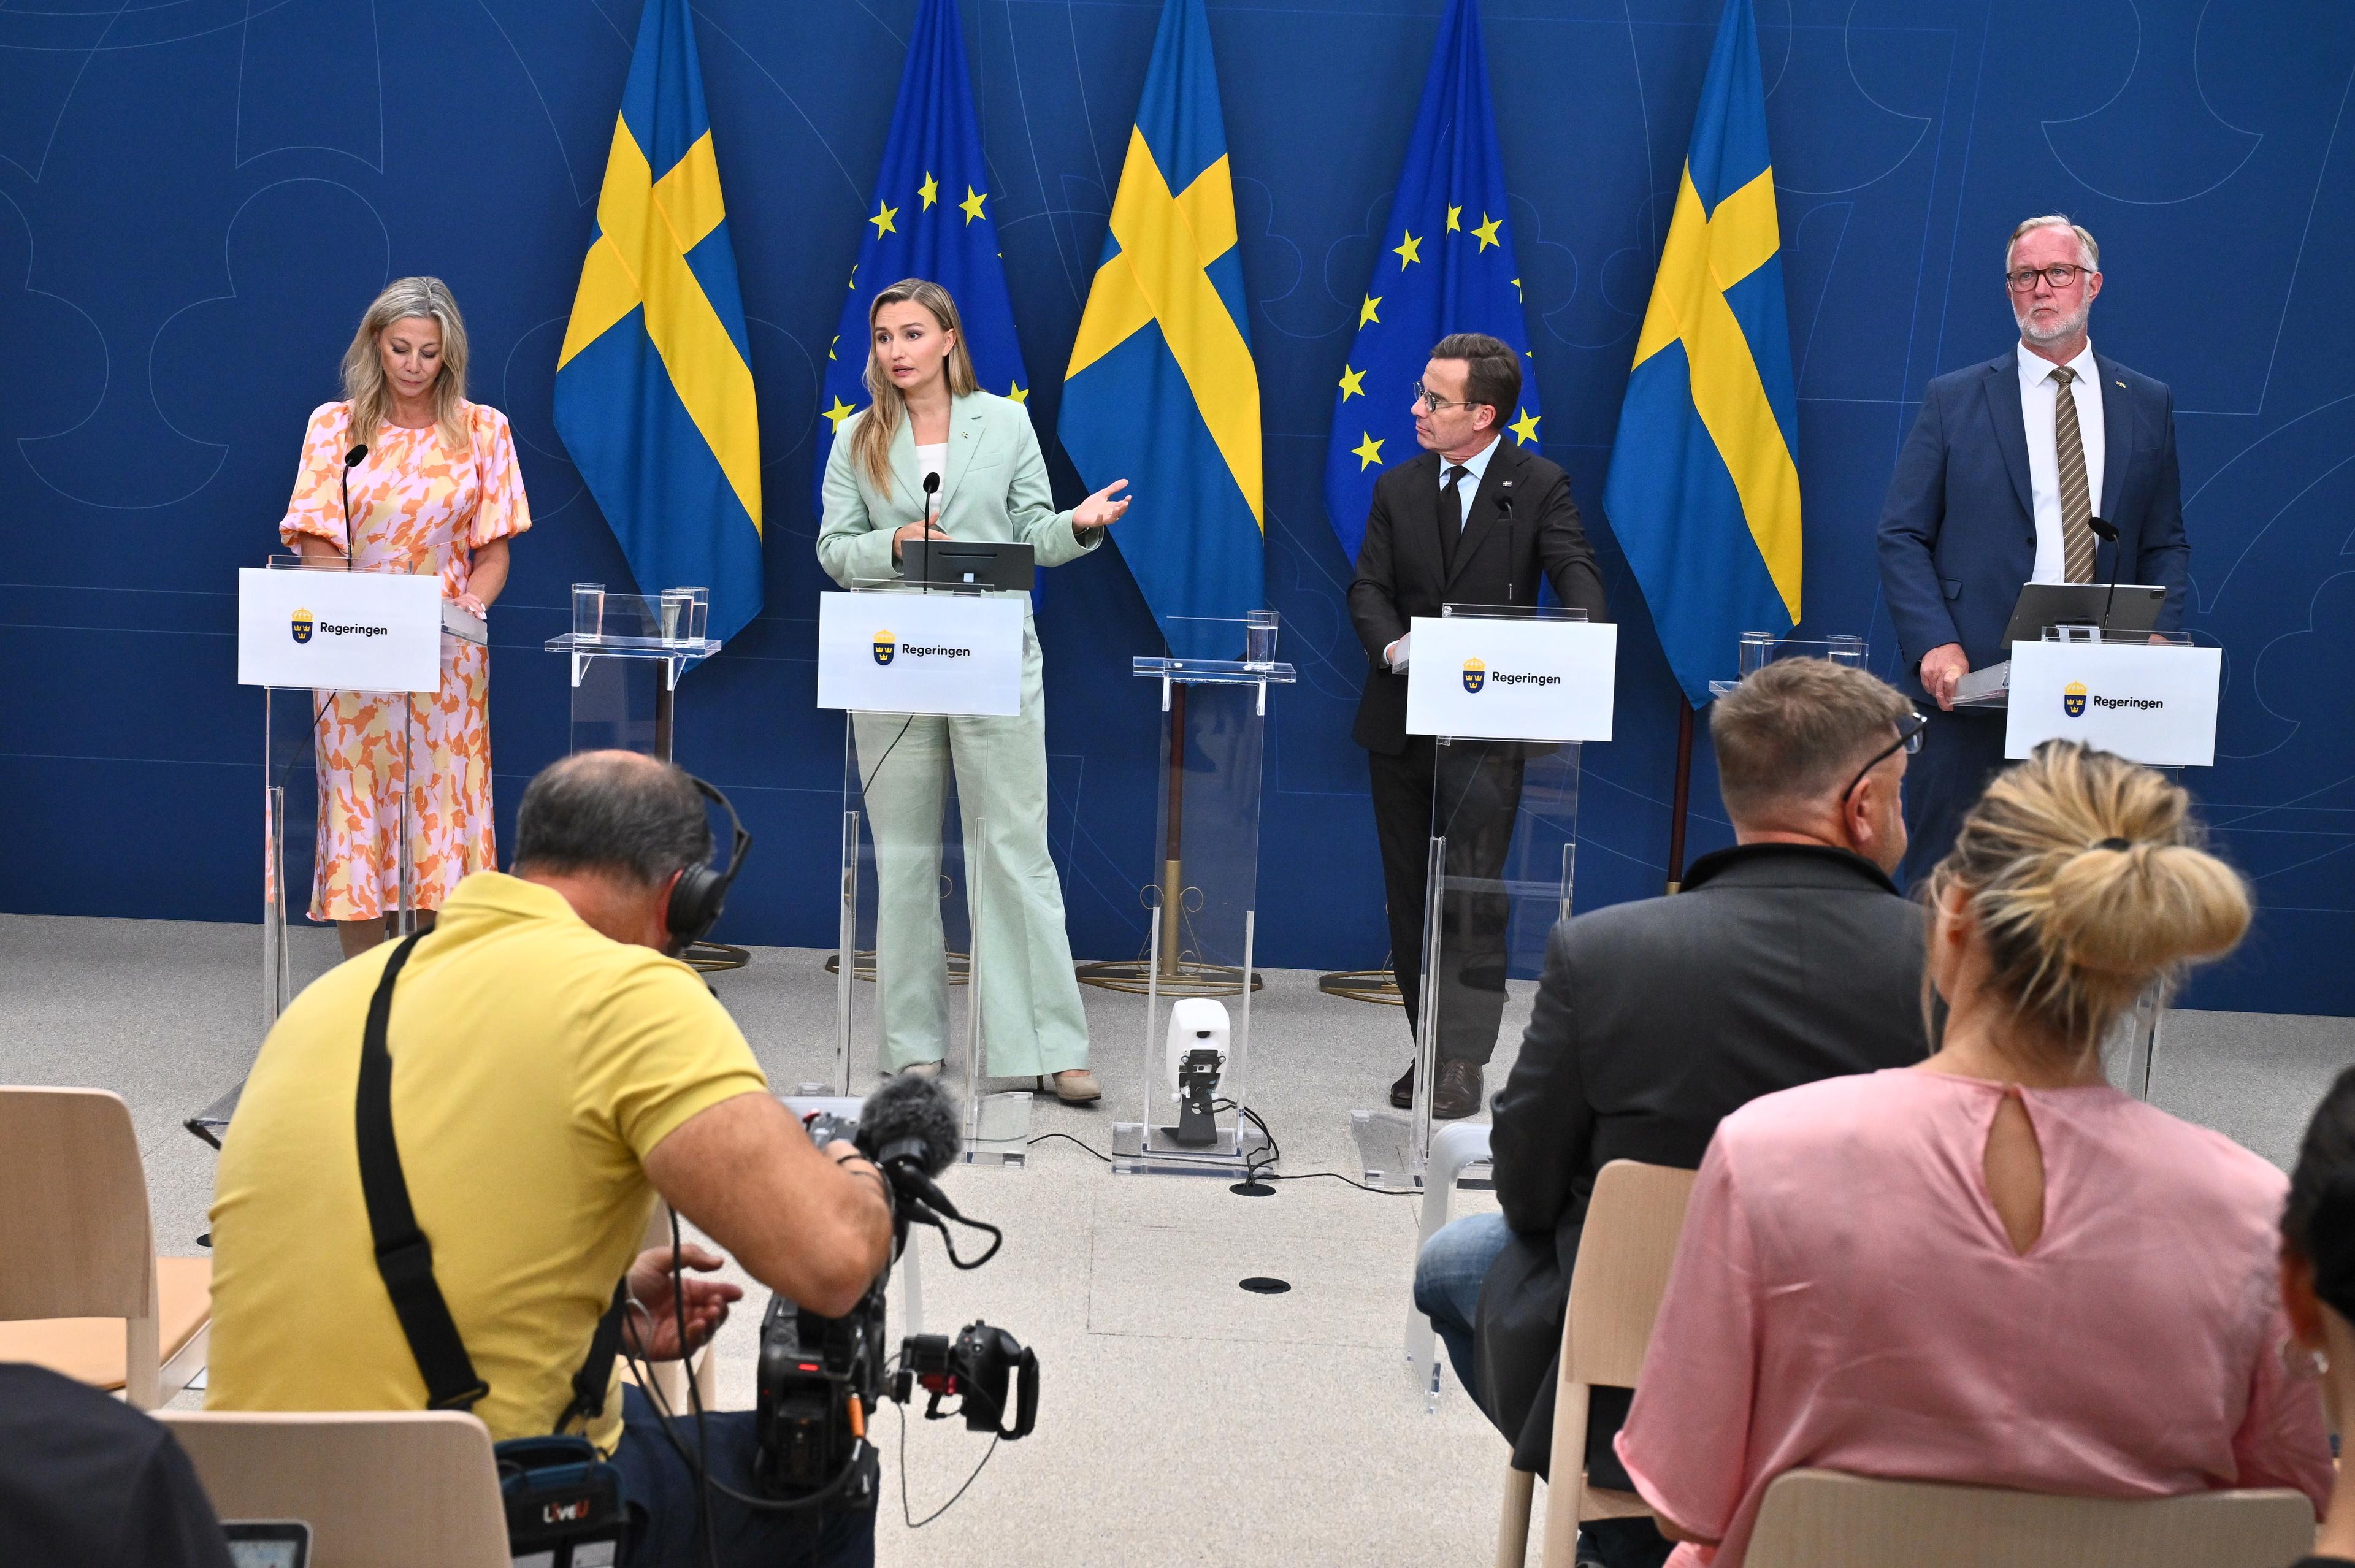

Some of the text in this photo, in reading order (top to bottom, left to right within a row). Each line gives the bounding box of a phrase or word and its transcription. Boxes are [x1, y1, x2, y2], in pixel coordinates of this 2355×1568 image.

[320, 622, 388, 637] Regeringen
[902, 643, 970, 659] Regeringen
[1492, 671, 1561, 686] Regeringen
[2093, 695, 2164, 711] Regeringen
[543, 1500, 590, 1523] LiveU
